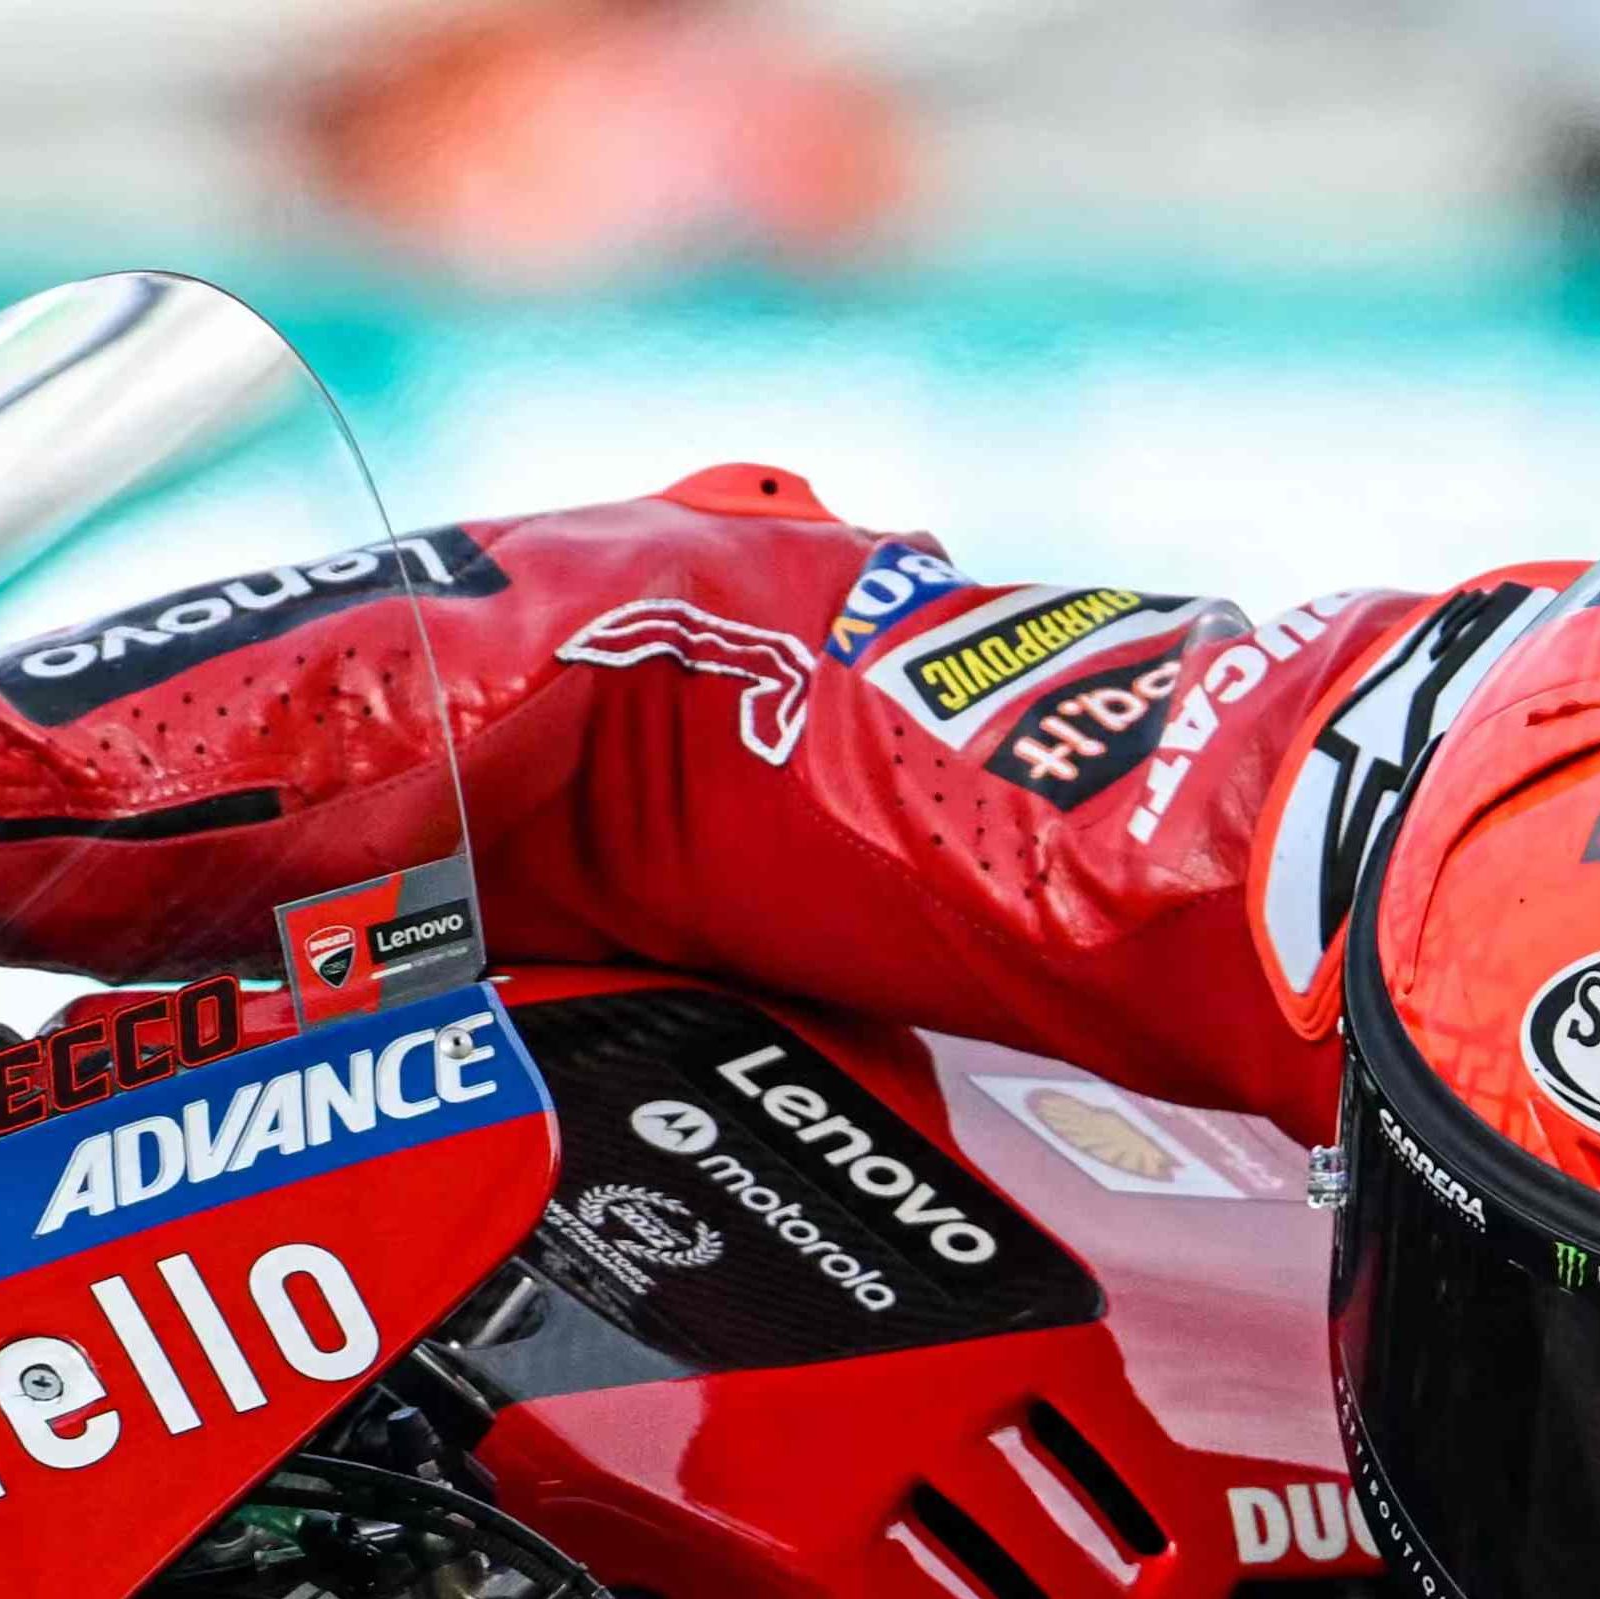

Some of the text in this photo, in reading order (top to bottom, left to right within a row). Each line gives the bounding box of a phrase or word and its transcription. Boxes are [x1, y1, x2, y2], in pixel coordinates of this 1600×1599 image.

[19, 535, 453, 680] Lenovo
[376, 913, 463, 952] Lenovo
[33, 1012, 497, 1240] ADVANCE
[715, 1045, 997, 1265] Lenovo
[1379, 1108, 1487, 1226] CARRERA
[697, 1155, 895, 1312] motorola
